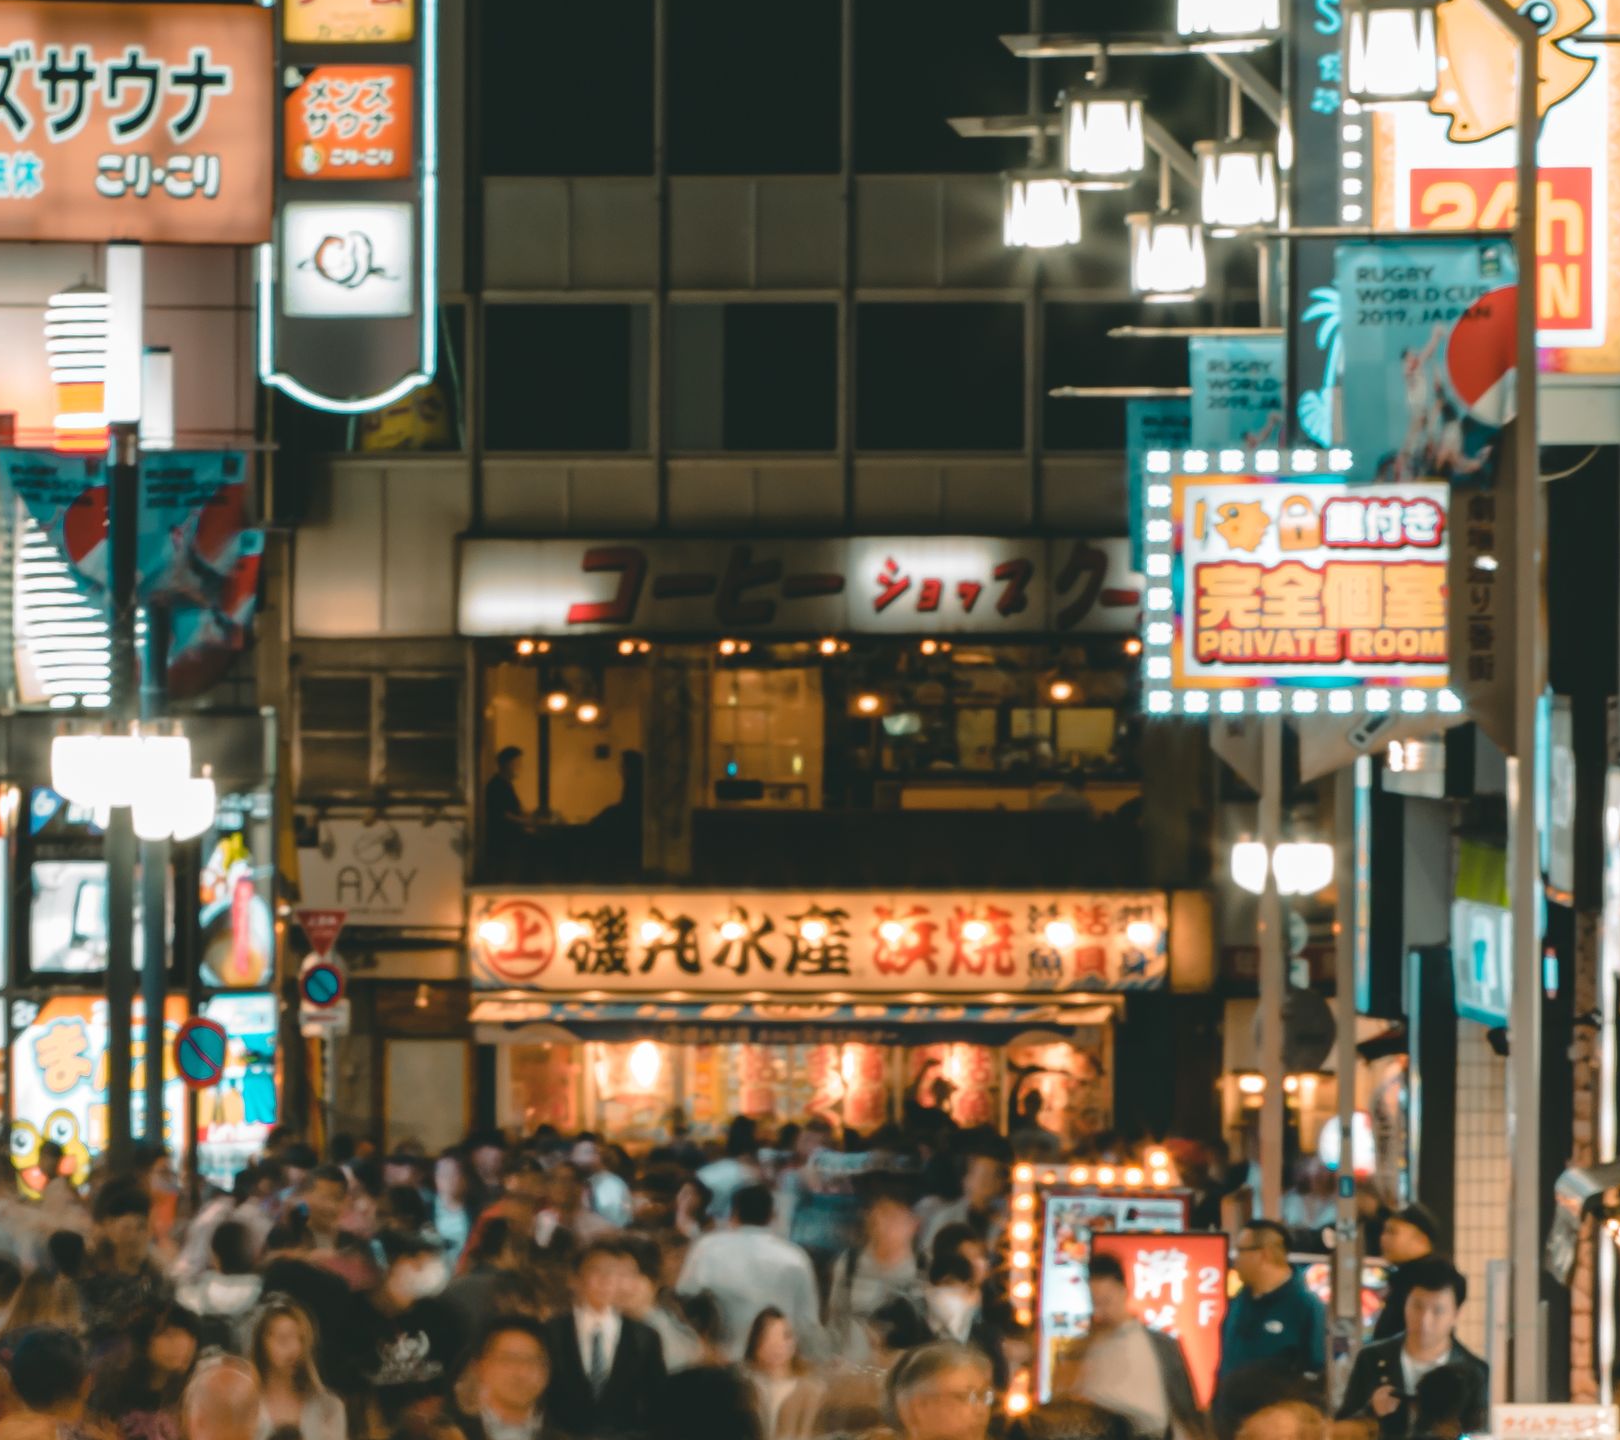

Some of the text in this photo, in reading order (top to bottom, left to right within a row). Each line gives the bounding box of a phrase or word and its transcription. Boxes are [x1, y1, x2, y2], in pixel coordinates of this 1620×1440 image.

[305, 78, 396, 108] メンズ
[305, 108, 396, 138] サウナ
[1356, 264, 1436, 285] RUGBY
[1197, 563, 1448, 632] 完全個室
[1197, 629, 1448, 659] PRIVATE ROOM
